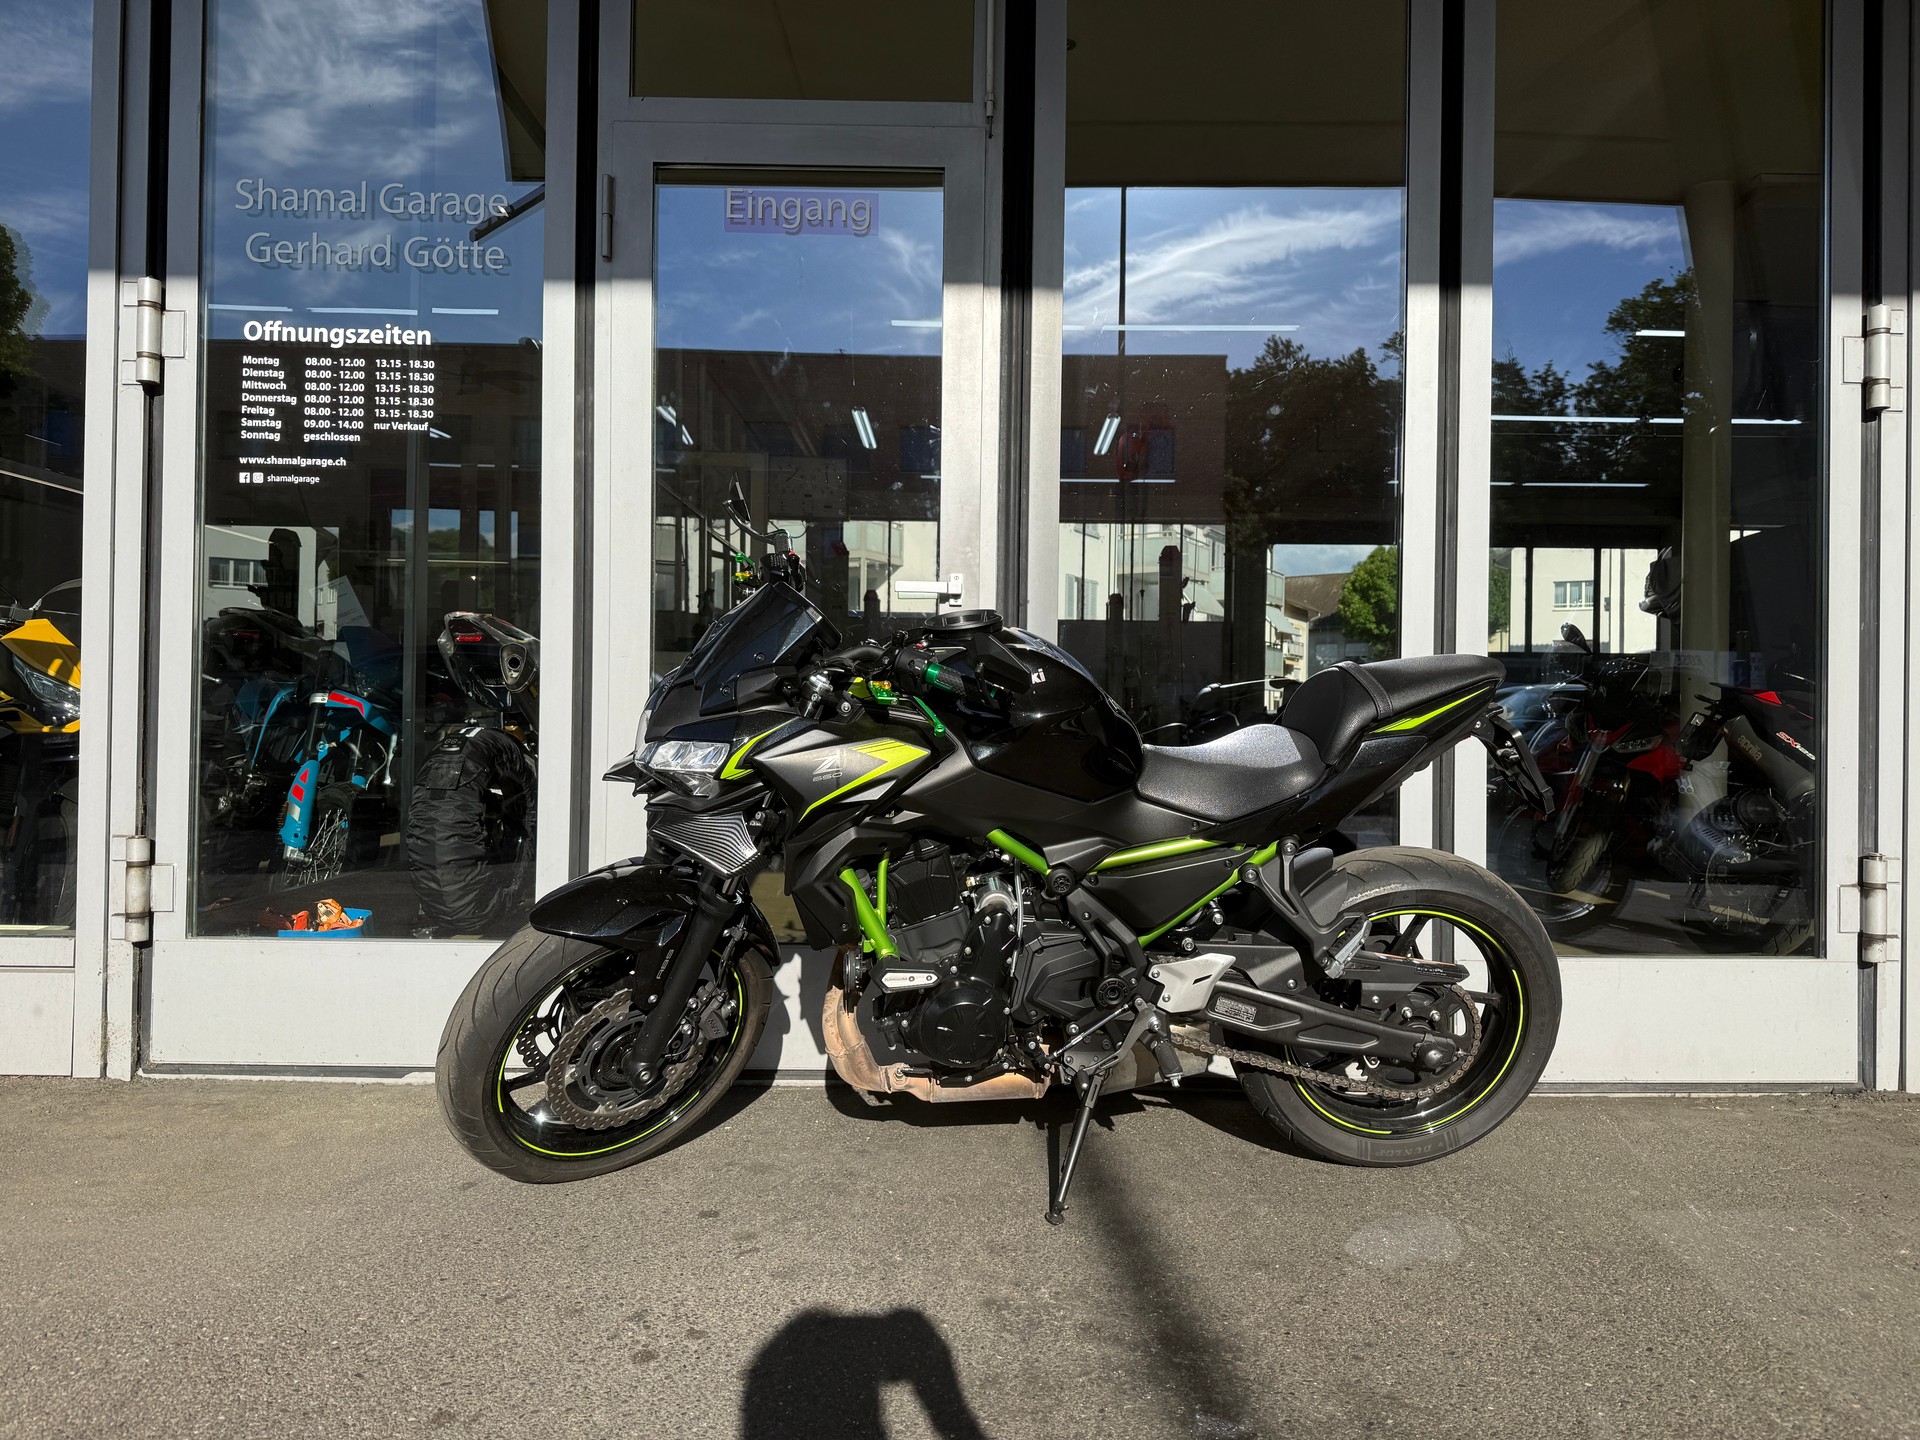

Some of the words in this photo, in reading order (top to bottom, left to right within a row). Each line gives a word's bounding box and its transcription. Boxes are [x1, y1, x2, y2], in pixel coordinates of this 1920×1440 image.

[234, 177, 367, 214] Shamal
[379, 182, 509, 225] Garage
[726, 188, 872, 231] Eingang
[245, 231, 392, 267] Gerhard
[404, 235, 505, 270] Götte
[243, 356, 279, 366] Montag
[305, 356, 332, 367] 08.00
[340, 357, 365, 368] 12.00
[376, 358, 401, 369] 13.15
[409, 359, 434, 369] 18.30
[243, 368, 284, 379] Dienstag
[305, 369, 331, 379] 08.00
[339, 370, 365, 380] 12.00
[376, 371, 401, 381] 13.15
[409, 372, 434, 382] 18.30
[242, 380, 286, 390] Mittwoch
[305, 381, 331, 392] 08.00
[339, 382, 364, 392] 12.00
[376, 383, 400, 393] 13.15
[409, 384, 434, 394] 18.30
[242, 393, 297, 405] Donnerstag
[305, 394, 331, 404] 08.00
[339, 395, 364, 405] 12.00
[375, 396, 400, 406] 13.15
[408, 397, 434, 407] 18.30
[242, 405, 274, 416] Freitag
[304, 406, 330, 416] 08.00
[338, 407, 364, 417] 12.00
[375, 408, 400, 418] 13.15
[408, 409, 433, 419] 18.30
[241, 418, 281, 429] Samstag
[304, 419, 330, 429] 09.00
[338, 420, 363, 430] 14.00
[374, 422, 390, 430] nur
[392, 421, 428, 431] Verkauf
[241, 430, 280, 441] Sonntag
[304, 432, 360, 442] geschlossen
[239, 456, 346, 467] www.shamalgarage.ch
[267, 474, 320, 484] shamalgarage
[1737, 735, 1762, 760] aprilia
